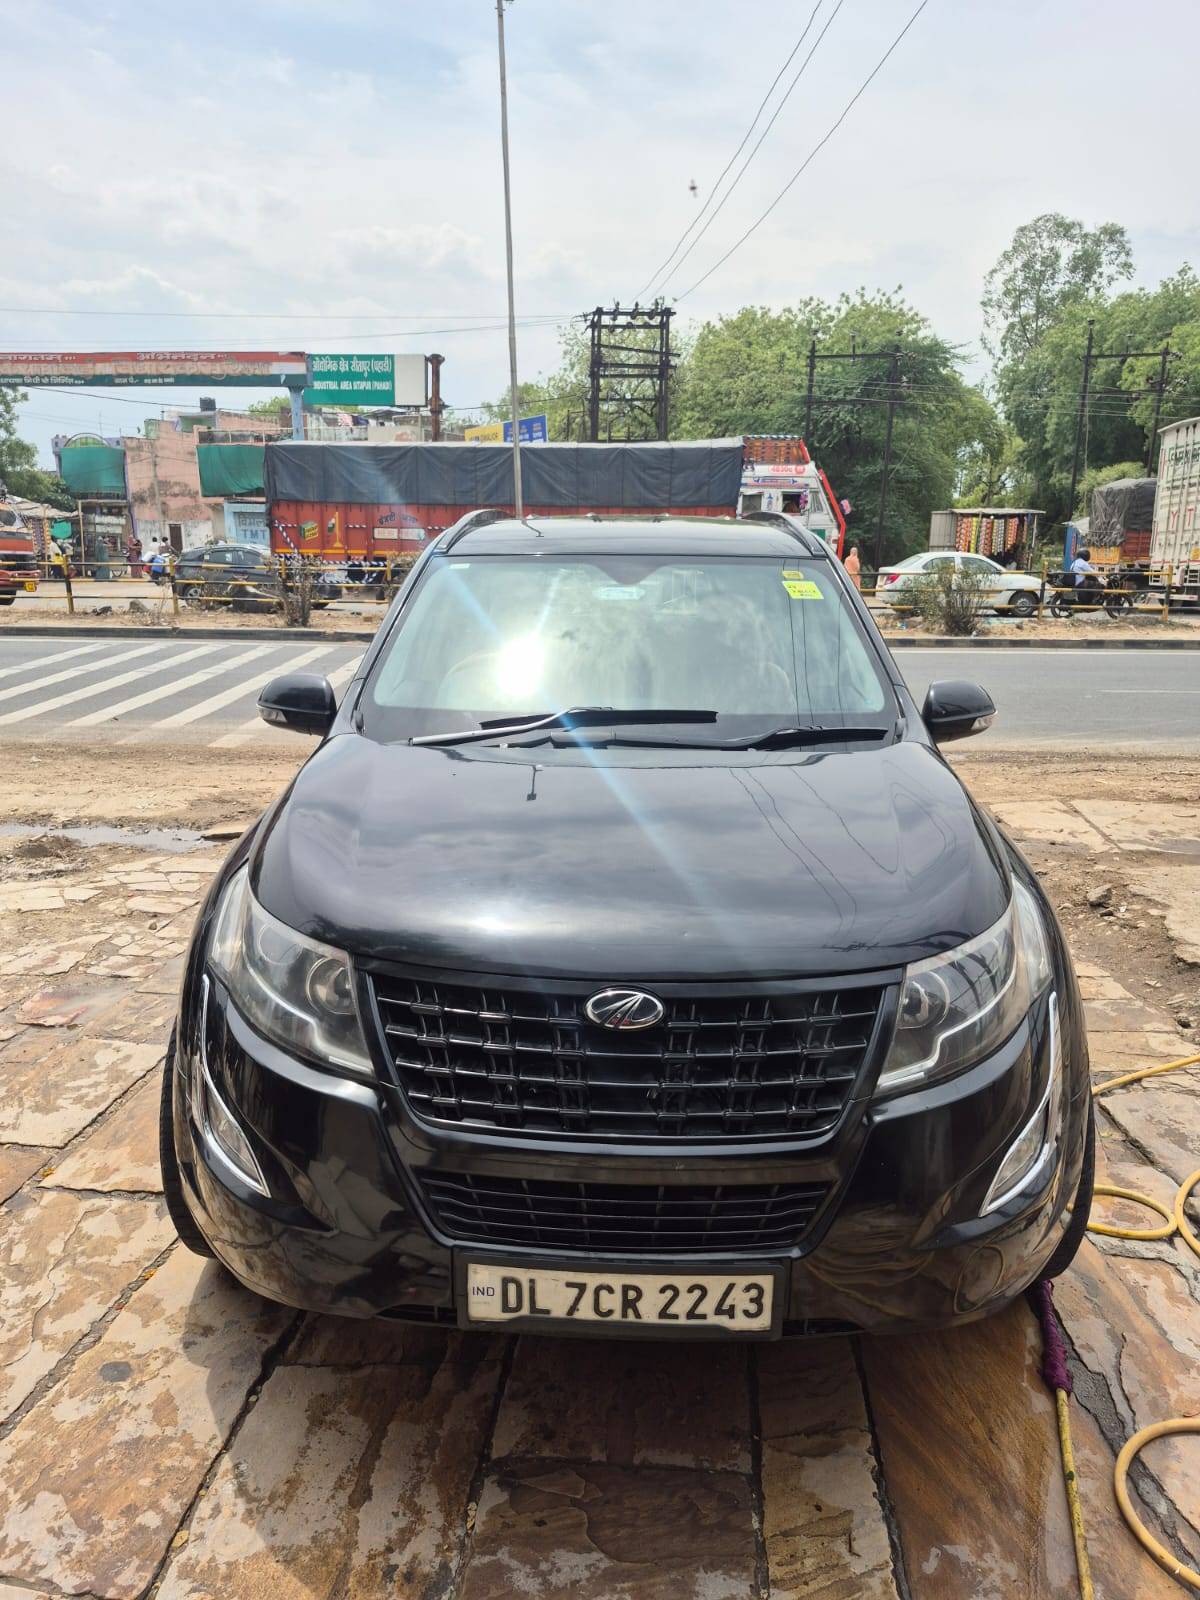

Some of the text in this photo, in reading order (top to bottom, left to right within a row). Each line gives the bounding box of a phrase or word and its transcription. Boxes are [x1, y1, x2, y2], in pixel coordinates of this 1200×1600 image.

[340, 381, 353, 390] AREA
[240, 529, 267, 539] TMT
[472, 1286, 495, 1297] IND
